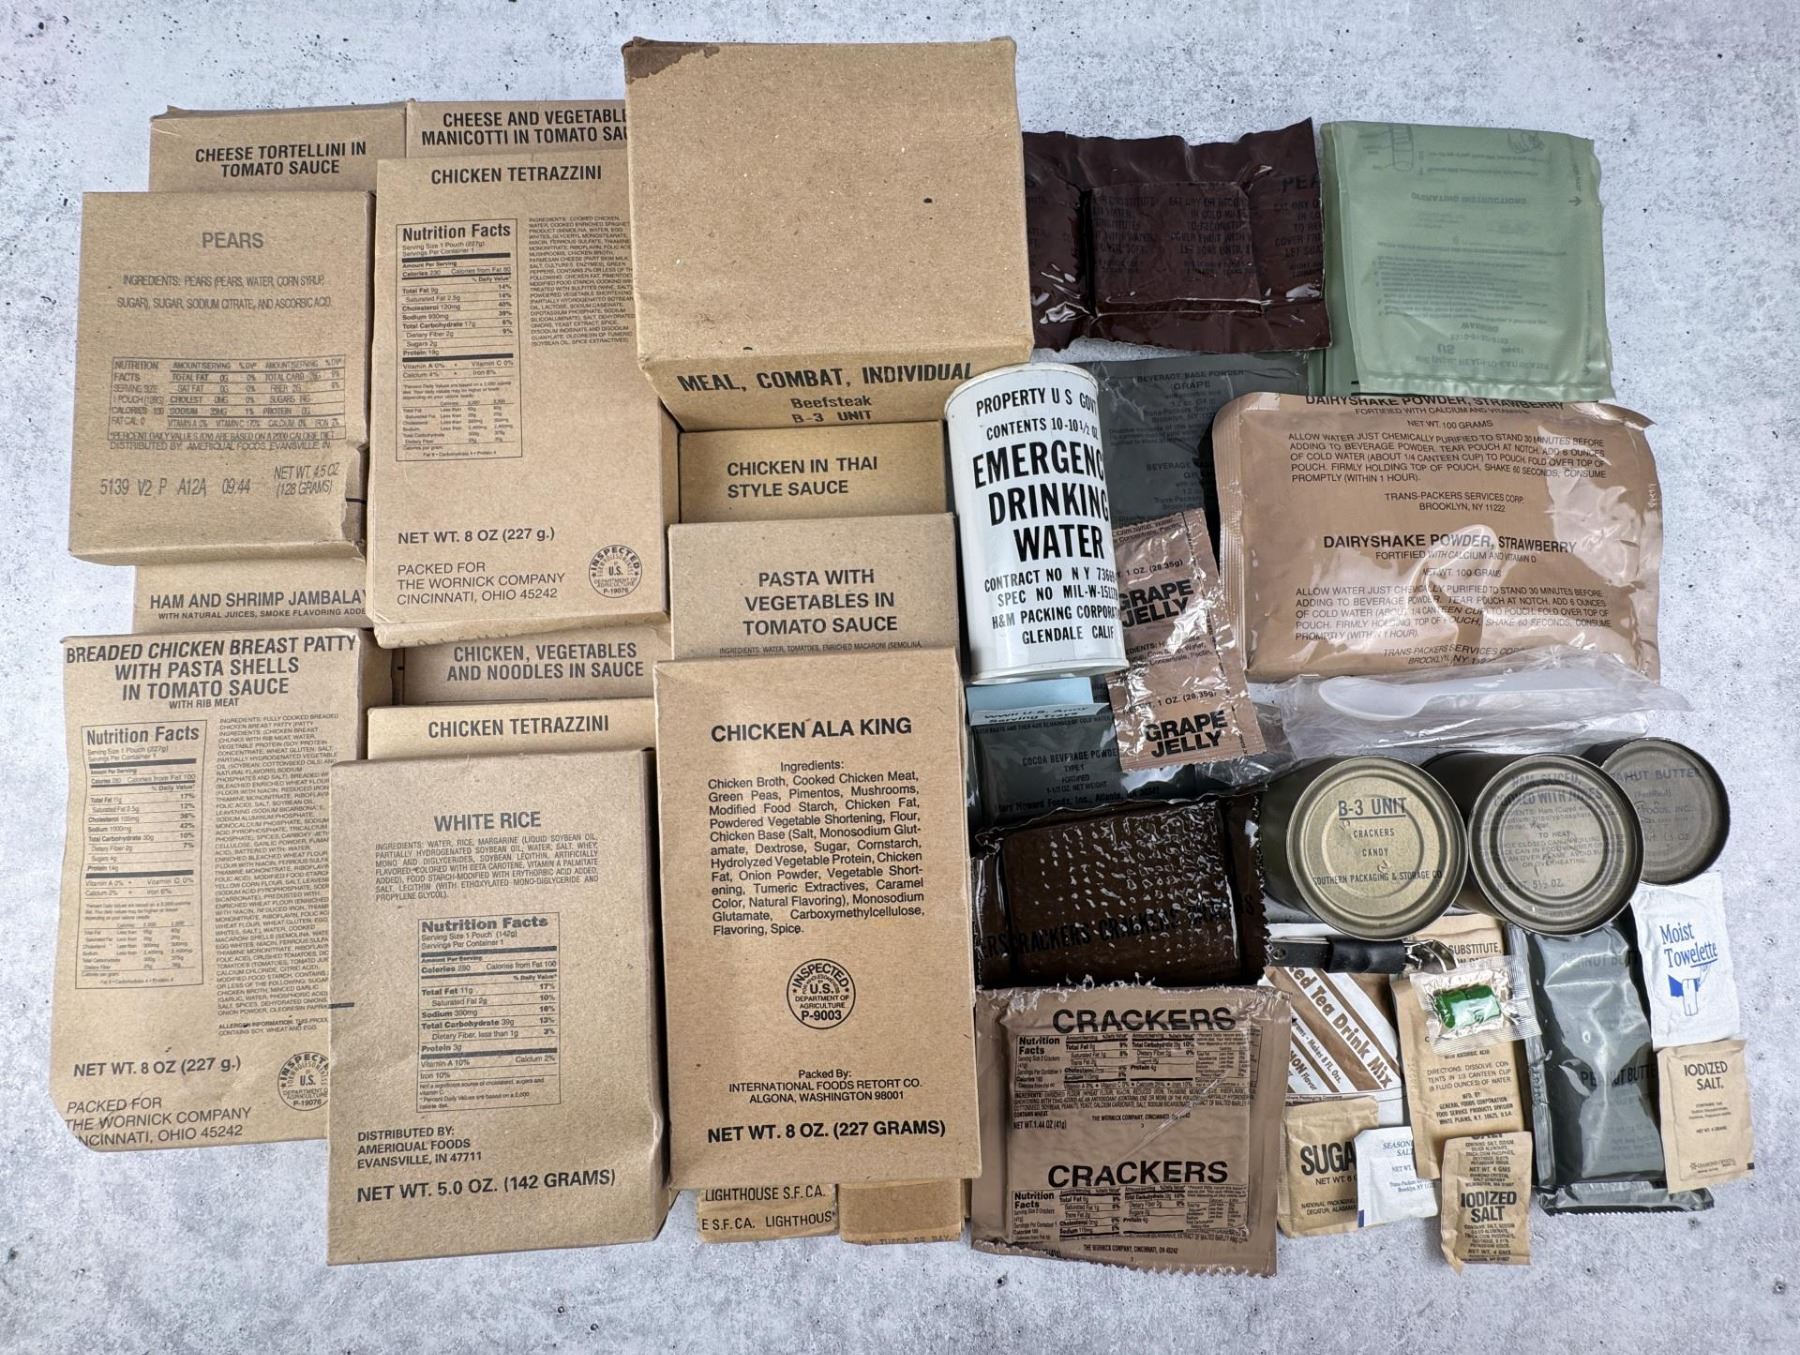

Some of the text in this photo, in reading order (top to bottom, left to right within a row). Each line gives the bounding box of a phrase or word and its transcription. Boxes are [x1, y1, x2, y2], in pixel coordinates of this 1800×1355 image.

[443, 113, 502, 127] CHEESE
[508, 111, 539, 125] AND
[422, 130, 508, 145] MANICOTTI
[514, 129, 529, 144] IN
[534, 127, 598, 144] TOMATO
[196, 141, 366, 162] CHEESE TORTELLINI IN
[221, 160, 340, 177] TOMATO SAUCE
[432, 165, 601, 185] CHICKEN TETRAZZINI
[202, 232, 264, 248] PEARS
[403, 223, 510, 241] Nutrition Facts
[678, 363, 973, 392] MEAL, COMBAT, INDIVIDUAL
[791, 396, 872, 409] Beefsteak
[976, 388, 1045, 417] PROPERTY
[792, 410, 872, 424] B-3 UNIT
[987, 417, 1047, 440] CONTENTS
[728, 456, 878, 476] CHICKEN IN THAI
[973, 440, 1105, 489] EMERGENC
[100, 479, 129, 495] 5139
[159, 478, 167, 495] P
[177, 478, 207, 496] A12A
[222, 478, 250, 495] 09:44
[728, 480, 848, 498] STYLE SAUCE
[988, 483, 1109, 526] DRINKING
[1419, 503, 1470, 512] BROOKLYN,
[1472, 503, 1483, 511] NY
[1014, 524, 1105, 562] WATER
[1324, 533, 1577, 553] DAIRYSHAKE POWDER, STRAWBERRY
[398, 562, 485, 576] PACKED FOR
[759, 569, 874, 587] PASTA WITH
[398, 572, 566, 591] THE WORNICK COMPANY
[984, 568, 1062, 593] CONTRACT NO
[150, 594, 184, 610] HAM
[189, 593, 222, 608] AND
[226, 591, 284, 607] SHRIMP
[397, 588, 558, 606] CINCINNATI, OHIO 45242
[746, 592, 894, 612] VEGETABLES IN
[158, 612, 179, 620] WITH
[182, 611, 222, 620] NATURAL
[260, 609, 290, 617] SMOKE
[1021, 606, 1072, 624] PACKING
[743, 616, 898, 636] TOMATO SAUCE
[1023, 626, 1083, 645] GLENDALE
[67, 635, 357, 663] BREADED CHICKEN BREAST PATTY
[454, 642, 637, 663] CHICKEN, VEGETABLES
[115, 657, 299, 681] WITH PASTA SHELLS
[447, 661, 644, 682] AND NOODLES IN SAUCE
[123, 677, 289, 701] IN TOMATO SAUCE
[169, 697, 239, 709] WITH RIB MEAT
[428, 715, 609, 738] CHICKEN TETRAZZINI
[711, 717, 912, 742] CHICKEN ALA KING
[1144, 710, 1228, 742] GRAPE
[1151, 730, 1222, 758] JELLY
[780, 760, 844, 772] Ingredients:
[708, 771, 919, 789] Chicken Broth, Cooked Chicken Meat,
[1338, 798, 1407, 816] B-3 UNIT
[434, 811, 541, 832] WHITE RICE
[1354, 828, 1394, 838] CRACKERS
[1362, 848, 1389, 857] CANDY
[1660, 923, 1694, 945] Moist
[1664, 941, 1718, 968] Towelette
[792, 962, 850, 989] INSPECTED
[810, 984, 834, 994] U.S.
[801, 1010, 842, 1021] P-9003
[1053, 1007, 1236, 1033] CRACKERS
[1310, 986, 1393, 1088] Tea Drink Mix
[1684, 1061, 1728, 1077] IODIZED
[729, 1078, 922, 1093] INTERNATIONAL FOODS RETORT CO.
[749, 1091, 904, 1104] ALGONA, WASHINGTON 98001
[358, 1126, 454, 1142] DISTRIBUTED BY:
[708, 1120, 946, 1143] NET WT. 8 OZ. (227 GRAMS)
[358, 1138, 471, 1156] AMERIQUAL FOODS
[358, 1151, 482, 1169] EVANSVILLE, IN 47711
[1300, 1141, 1357, 1176] SUGA
[1048, 1160, 1228, 1188] CRACKERS
[705, 1187, 779, 1201] LIGHTHOUSE
[1461, 1191, 1517, 1208] IODIZED
[1471, 1206, 1505, 1223] SALT
